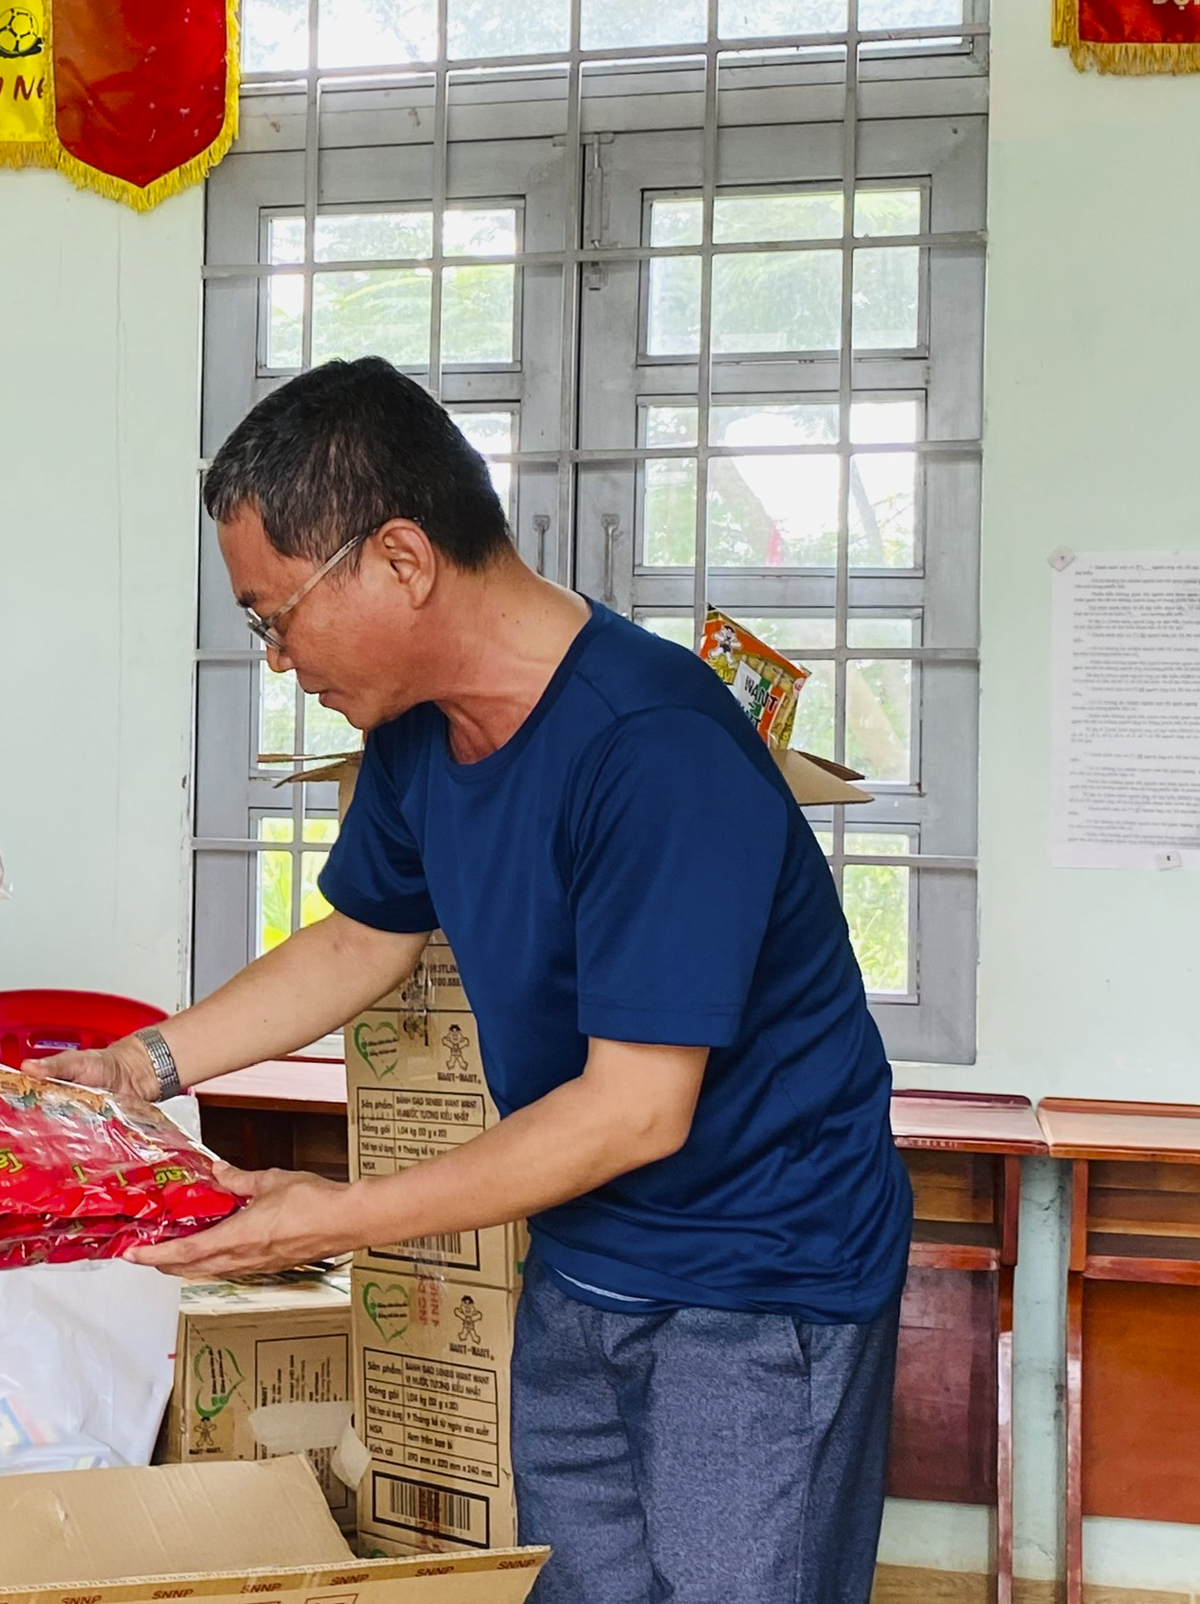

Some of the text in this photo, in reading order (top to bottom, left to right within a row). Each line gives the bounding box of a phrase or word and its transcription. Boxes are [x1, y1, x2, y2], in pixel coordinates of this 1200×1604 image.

[745, 675, 779, 712] WANT
[497, 1559, 536, 1571] SNNP
[415, 1566, 455, 1577] SNNP
[329, 1574, 370, 1586] SNNP
[152, 1588, 194, 1600] SNNP
[240, 1582, 282, 1594] SNNP
